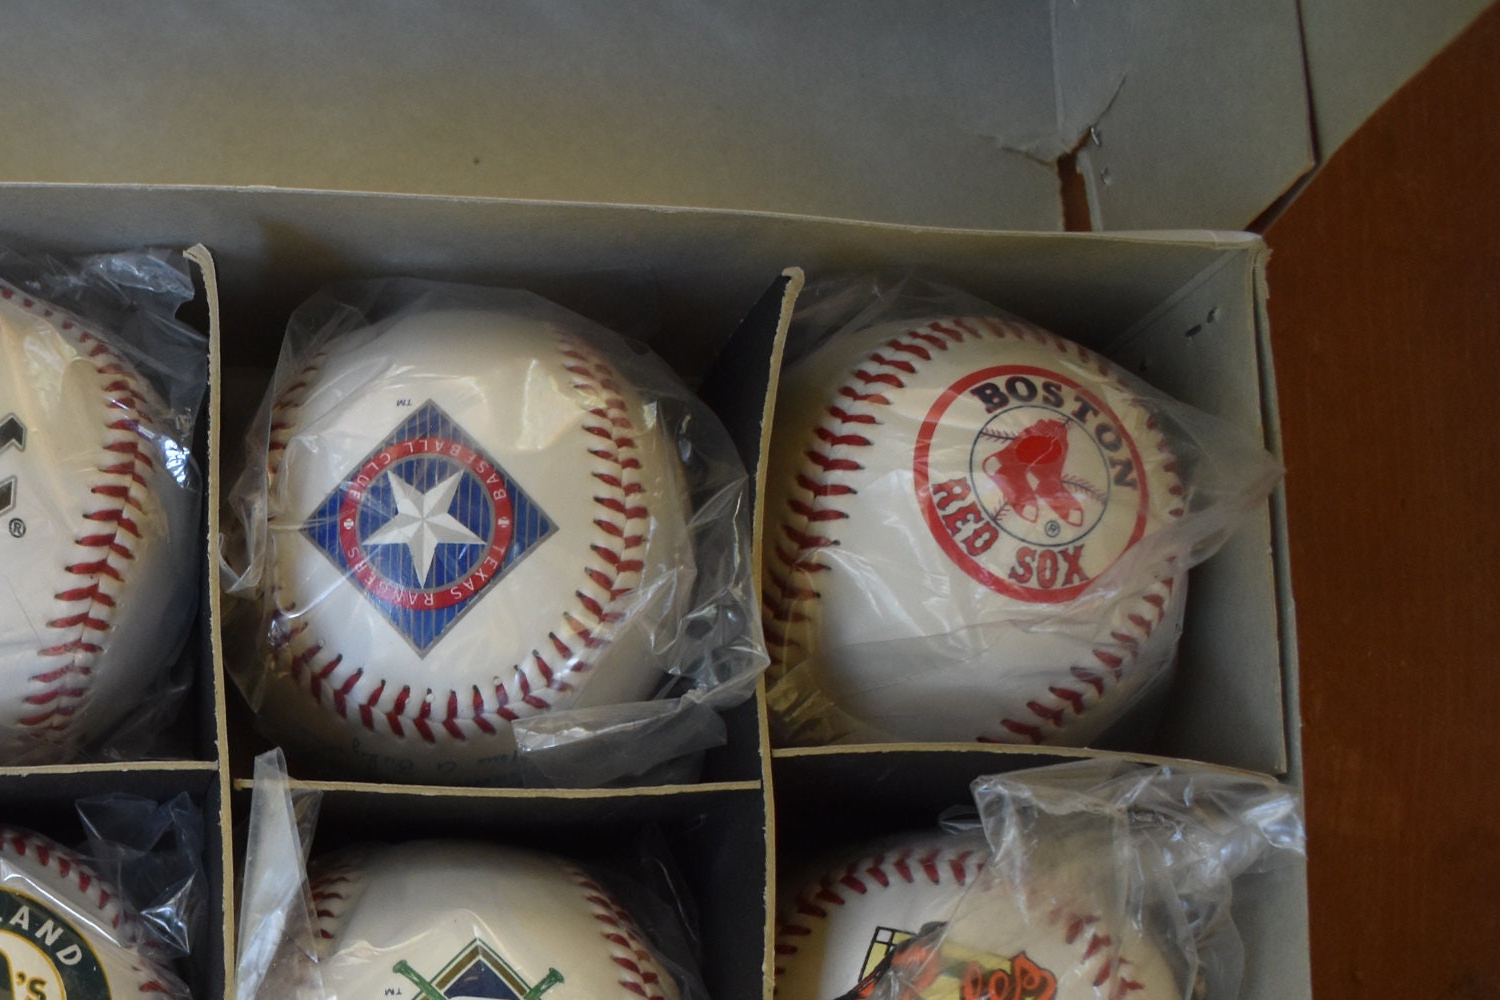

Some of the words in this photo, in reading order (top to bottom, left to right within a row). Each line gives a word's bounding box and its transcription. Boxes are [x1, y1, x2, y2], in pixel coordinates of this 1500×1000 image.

[970, 376, 1140, 492] BOSTON
[404, 440, 508, 500] BASEBALL
[931, 477, 999, 557] RED
[1008, 544, 1091, 588] SOX
[347, 547, 435, 607] RANGERS
[450, 545, 506, 600] TEXAS
